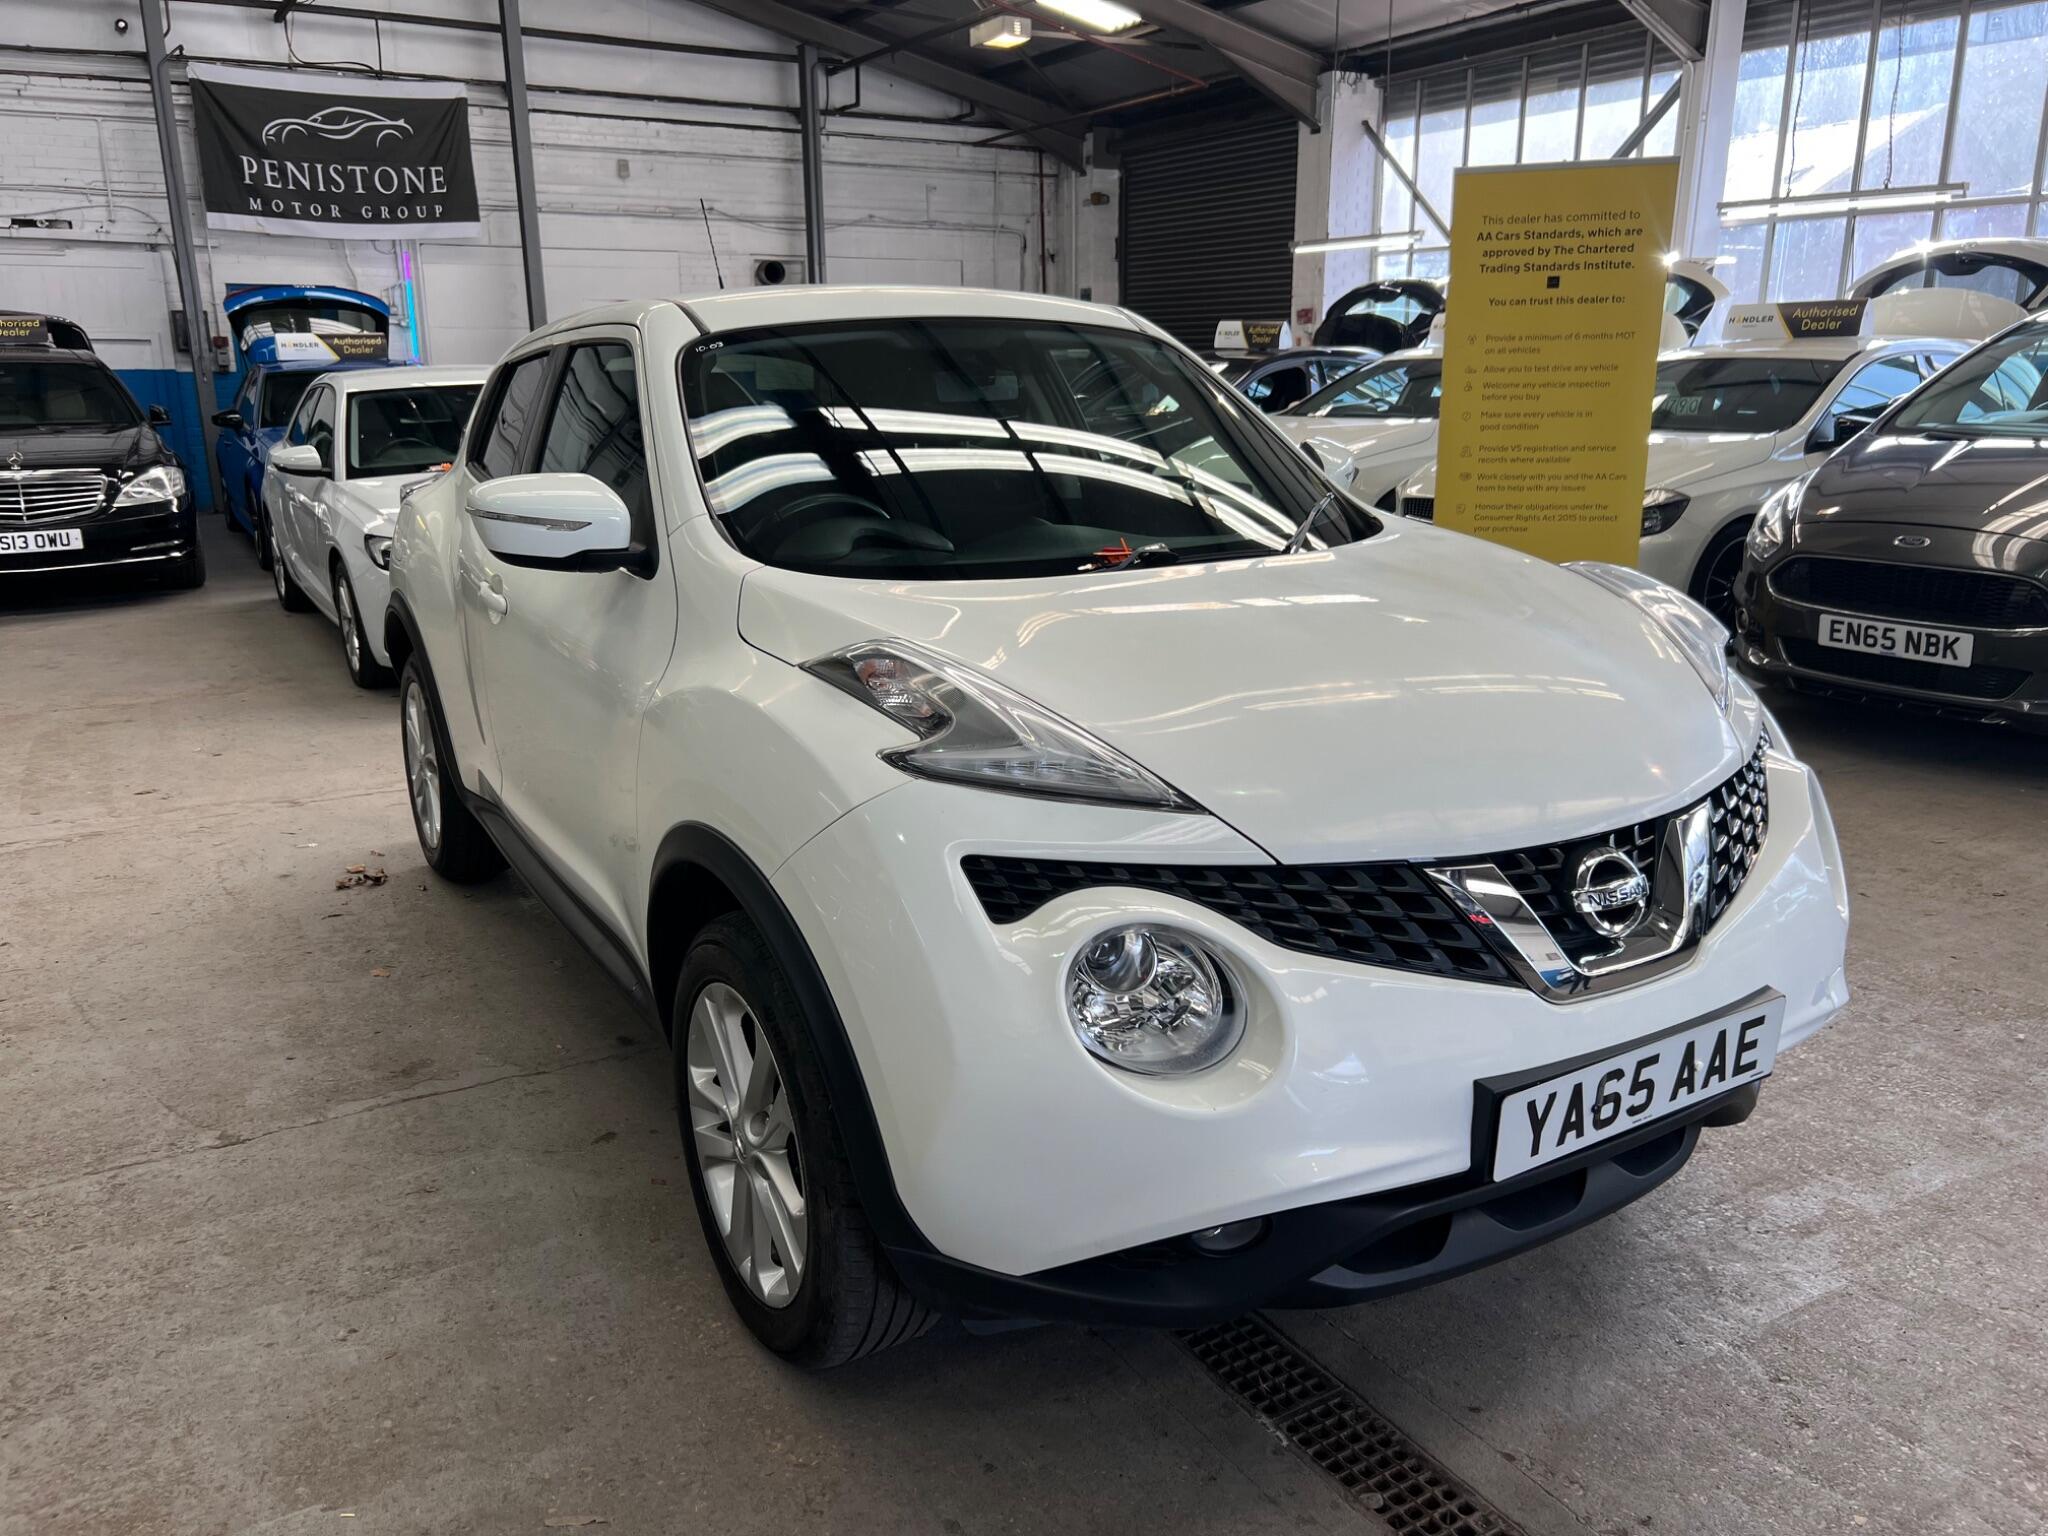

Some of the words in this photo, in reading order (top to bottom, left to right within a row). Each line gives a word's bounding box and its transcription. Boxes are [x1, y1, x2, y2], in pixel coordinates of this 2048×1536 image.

[239, 155, 447, 195] PENISTONE
[250, 197, 342, 217] MOTOR
[362, 205, 443, 219] GROUP
[1482, 215, 1504, 225] This
[1506, 214, 1541, 225] dealer
[1544, 212, 1563, 223] has
[1566, 210, 1626, 222] committed
[1629, 211, 1641, 220] to
[1476, 232, 1493, 241] AA
[1496, 231, 1521, 241] Cars
[1524, 229, 1585, 240] Standards,
[1587, 227, 1622, 238] which
[1624, 227, 1643, 236] are
[1482, 247, 1535, 259] approved
[1537, 246, 1550, 257] by
[1553, 245, 1574, 255] The
[1577, 243, 1635, 254] Chartered
[1479, 263, 1520, 275] Trading
[1523, 261, 1580, 272] Standards
[1584, 260, 1634, 270] Institute.
[1488, 297, 1506, 307] You
[1509, 298, 1527, 306] can
[1529, 297, 1553, 305] trust
[1556, 296, 1574, 305] this
[1576, 295, 1609, 304] dealer
[1611, 295, 1625, 304] to:
[1792, 304, 1858, 318] Authorised
[1801, 318, 1841, 330] Dealer
[333, 337, 382, 345] Authorised
[1485, 334, 1516, 342] Provide
[1525, 333, 1562, 342] minimum
[1564, 333, 1573, 341] of
[1582, 331, 1614, 340] months
[1616, 331, 1635, 340] MOT
[343, 346, 374, 354] Dealer
[1508, 346, 1541, 354] vehicles
[1483, 365, 1506, 374] Allow
[1507, 366, 1522, 374] you
[1551, 364, 1571, 372] drive
[1573, 365, 1588, 373] any
[1590, 363, 1619, 371] vehicle
[1483, 381, 1520, 390] Welcome
[1522, 382, 1535, 390] any
[1537, 380, 1566, 389] vehicle
[1568, 380, 1611, 389] inspection
[1481, 393, 1507, 401] before
[1509, 394, 1523, 402] you
[1526, 393, 1541, 401] buy
[1481, 411, 1501, 419] Make
[1523, 411, 1544, 419] every
[1546, 410, 1575, 418] vehicle
[1480, 423, 1499, 432] good
[1501, 423, 1539, 431] condition
[1524, 444, 1568, 453] registration
[1570, 444, 1586, 452] and
[1536, 456, 1571, 464] available
[1477, 473, 1498, 481] Work
[1499, 473, 1526, 481] closely
[1609, 473, 1627, 481] Cars
[1507, 484, 1524, 493] help
[1545, 485, 1559, 493] any
[1829, 619, 1896, 650] EN65
[1904, 630, 1961, 660] NBK
[1588, 882, 1646, 906] NISSAN
[1527, 1052, 1661, 1158] YA65
[1668, 1014, 1766, 1102] AAE
